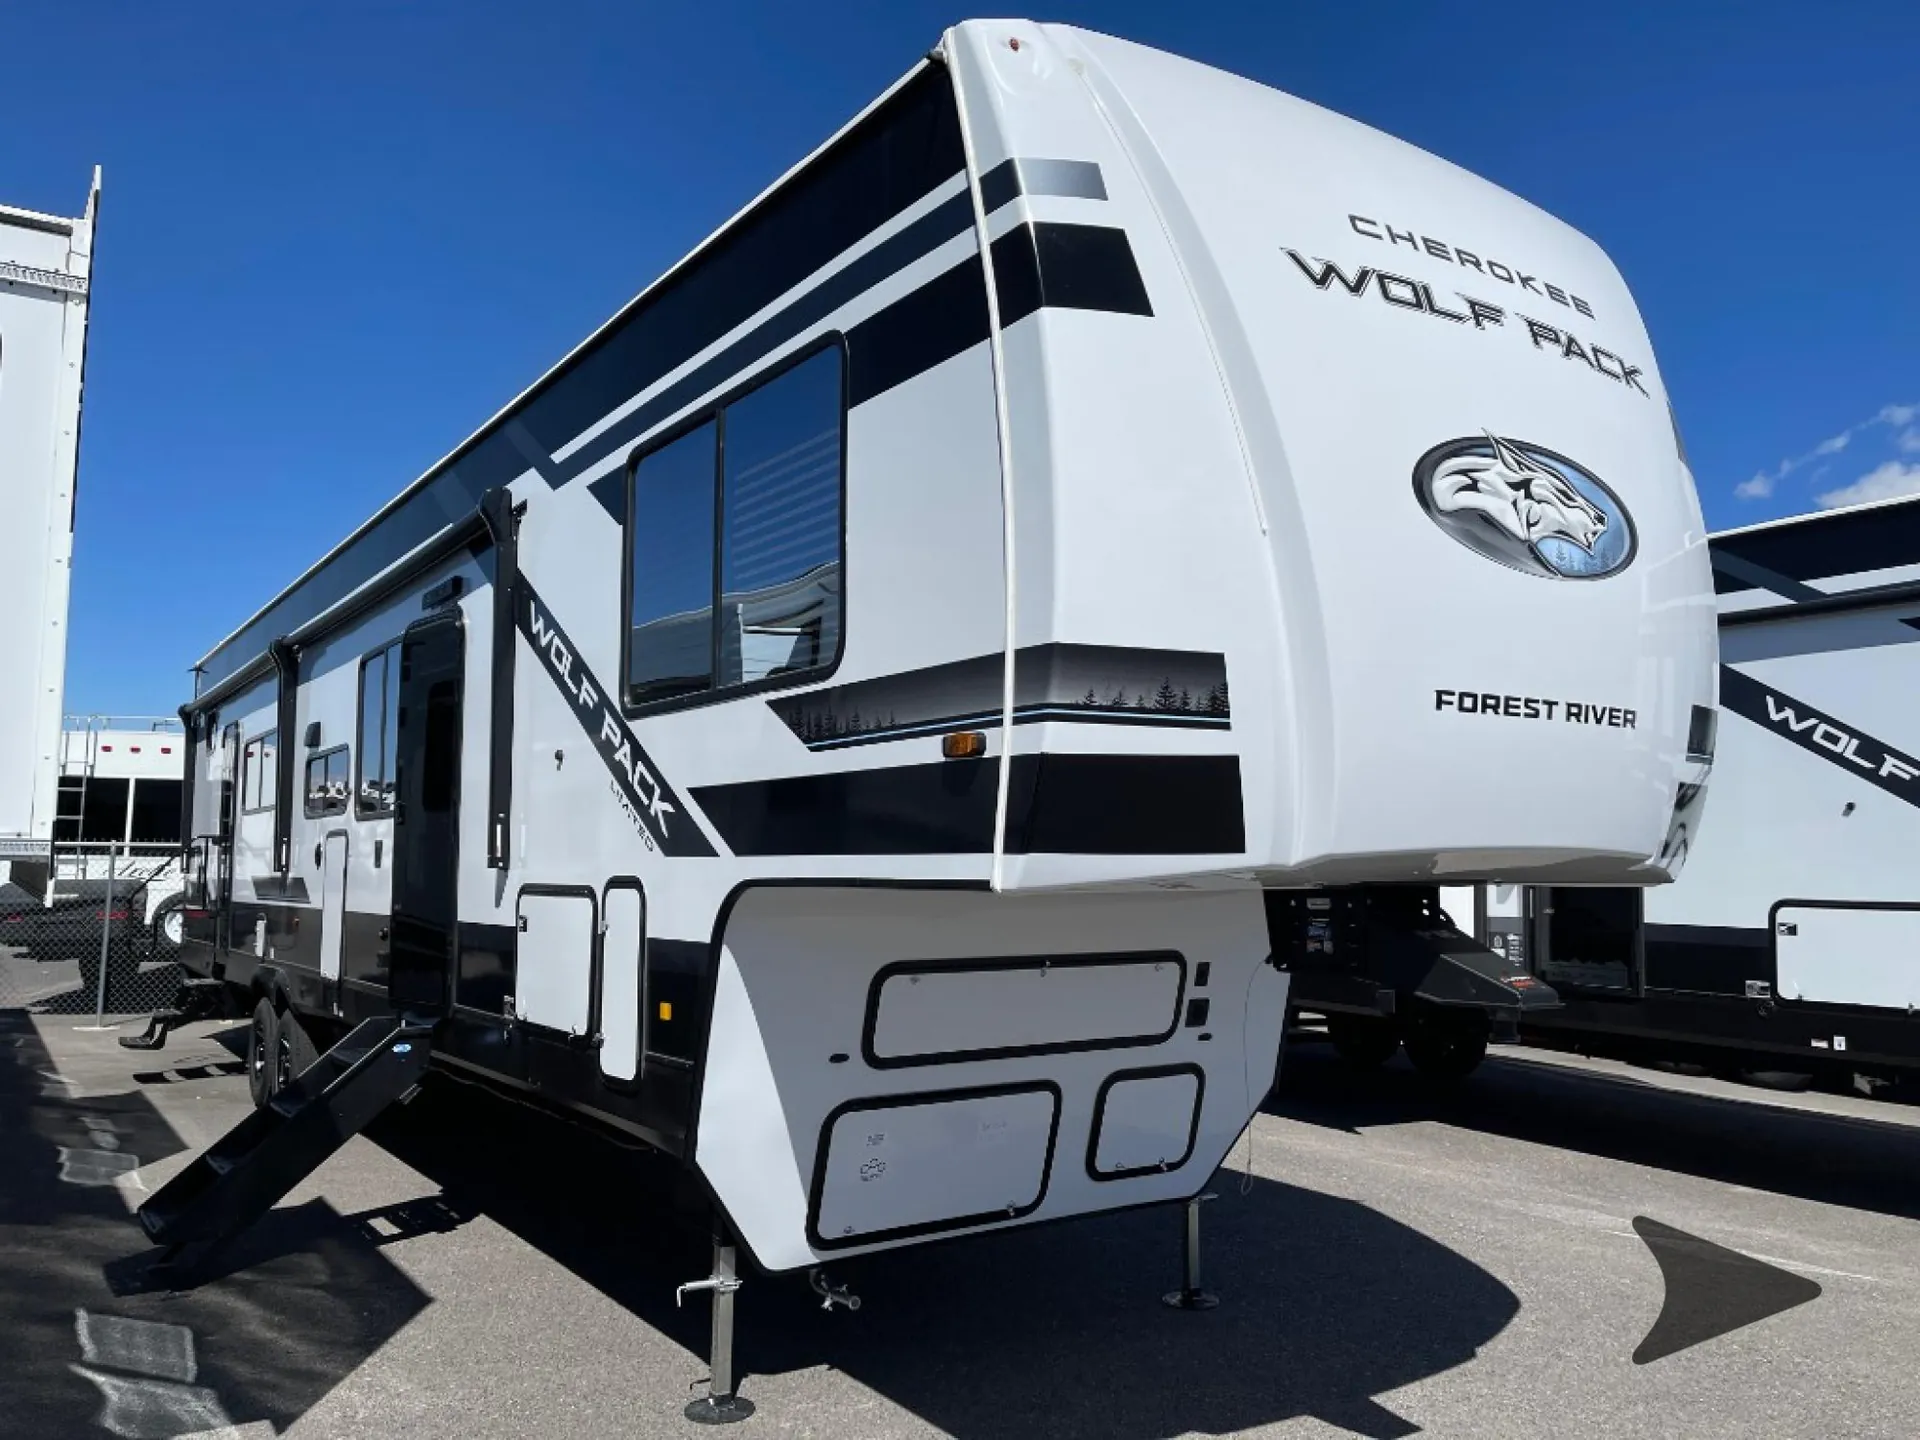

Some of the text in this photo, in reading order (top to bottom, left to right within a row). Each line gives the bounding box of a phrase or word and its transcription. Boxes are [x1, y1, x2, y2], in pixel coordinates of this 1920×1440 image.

[1348, 213, 1596, 321] CHEROKEE
[1279, 247, 1650, 399] WOLF PACK
[530, 600, 676, 838] WOLF PACK
[1434, 689, 1637, 729] FOREST RIVER
[1765, 695, 1920, 781] WOLF
